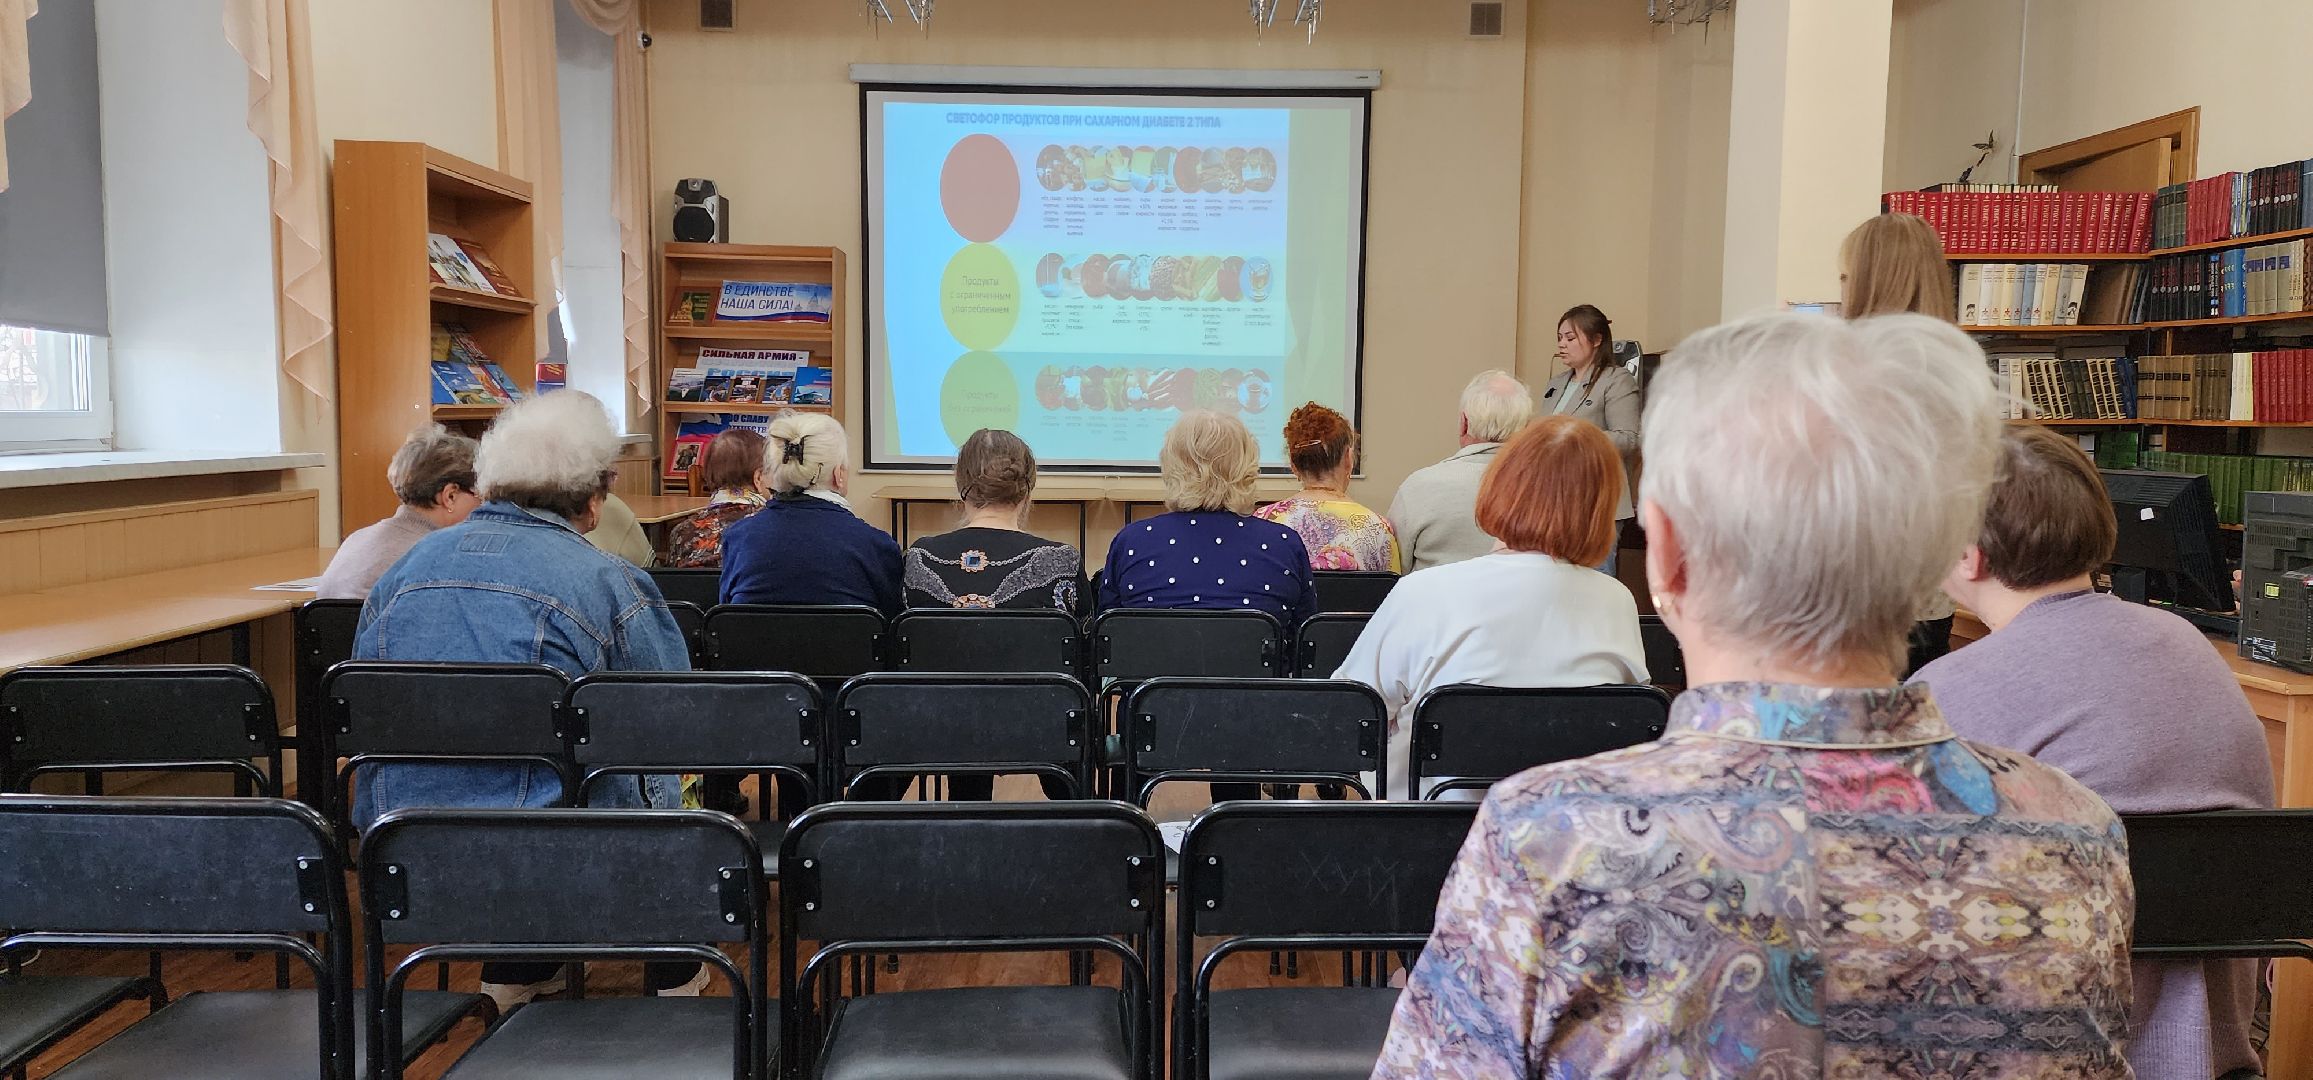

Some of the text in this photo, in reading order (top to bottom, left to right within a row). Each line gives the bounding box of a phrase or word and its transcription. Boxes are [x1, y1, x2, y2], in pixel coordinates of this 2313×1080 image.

[946, 111, 1221, 128] СВЕТОФОР ПРОДУКТОВ ПРИ САХАРНОМ ДИАБЕТЕ 2 ТИПА
[723, 284, 794, 297] В ЕДИНСТВЕ
[720, 297, 755, 309] НАША
[758, 298, 794, 311] СИЛА!
[702, 349, 755, 360] СИЛЬНАЯ
[757, 351, 797, 361] АРМИЯ
[741, 414, 769, 423] СЛАВУ
